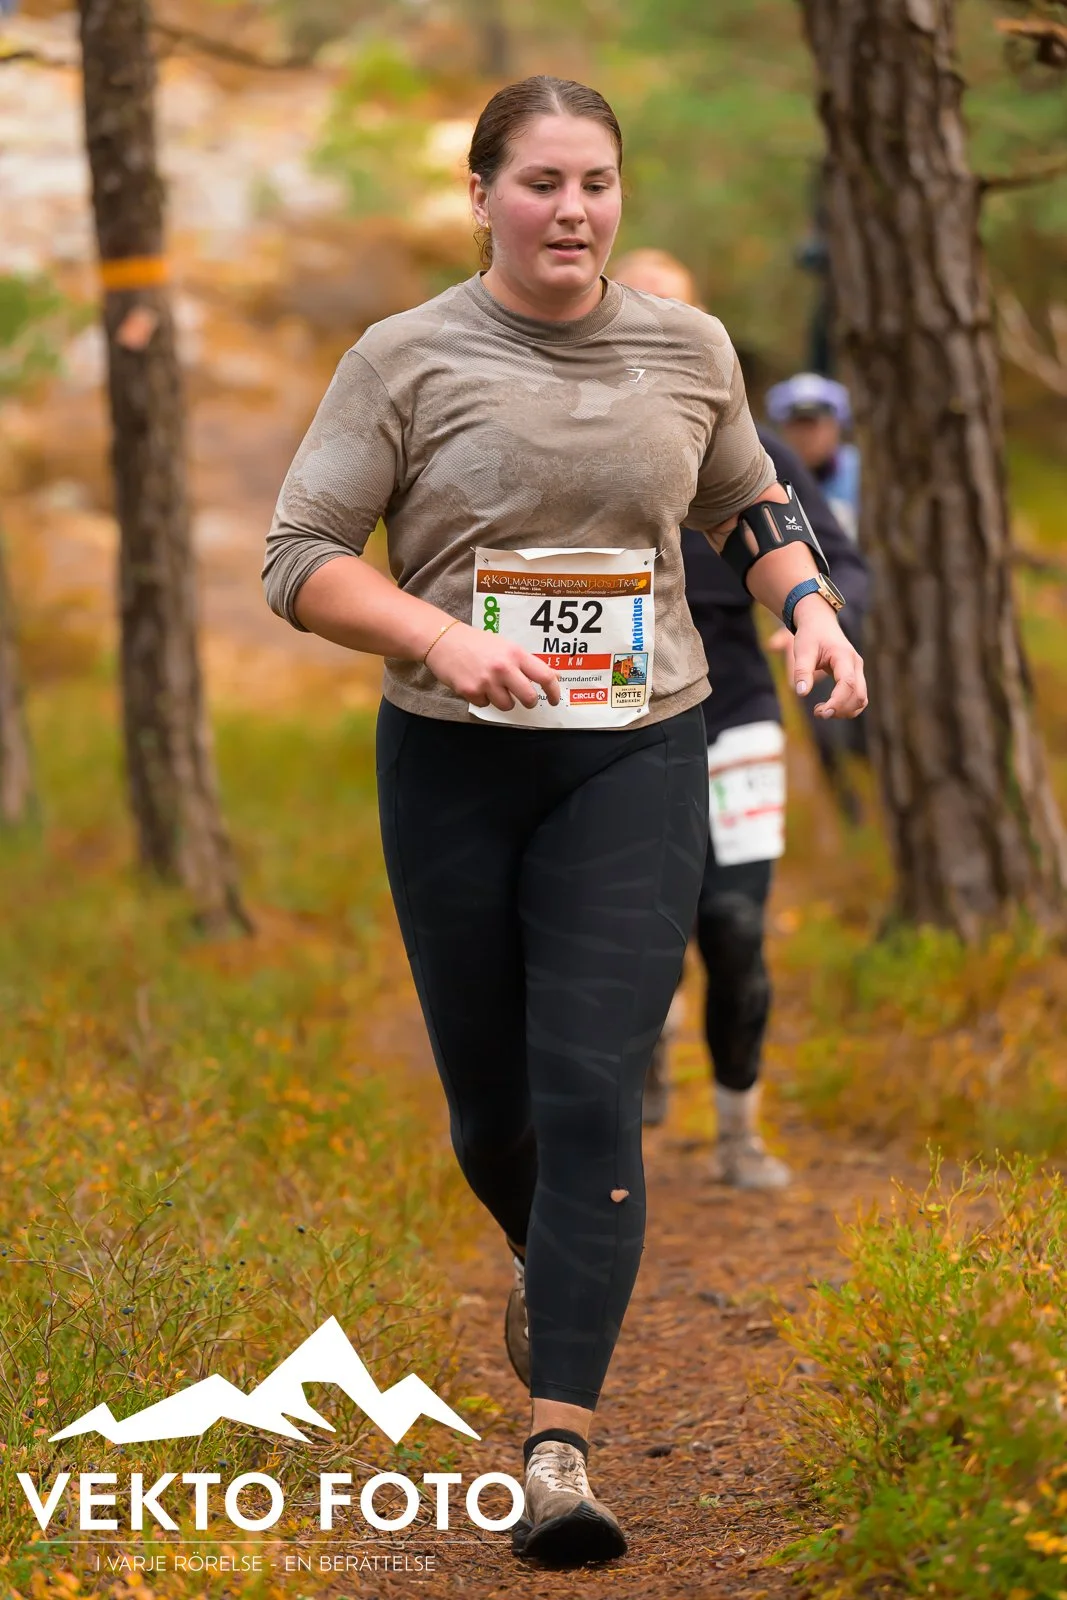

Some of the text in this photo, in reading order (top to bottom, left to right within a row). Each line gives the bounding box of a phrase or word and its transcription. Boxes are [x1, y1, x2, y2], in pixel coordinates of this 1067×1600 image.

[530, 599, 603, 634] 452
[632, 597, 643, 652] Aktivitus
[543, 637, 588, 655] Maja
